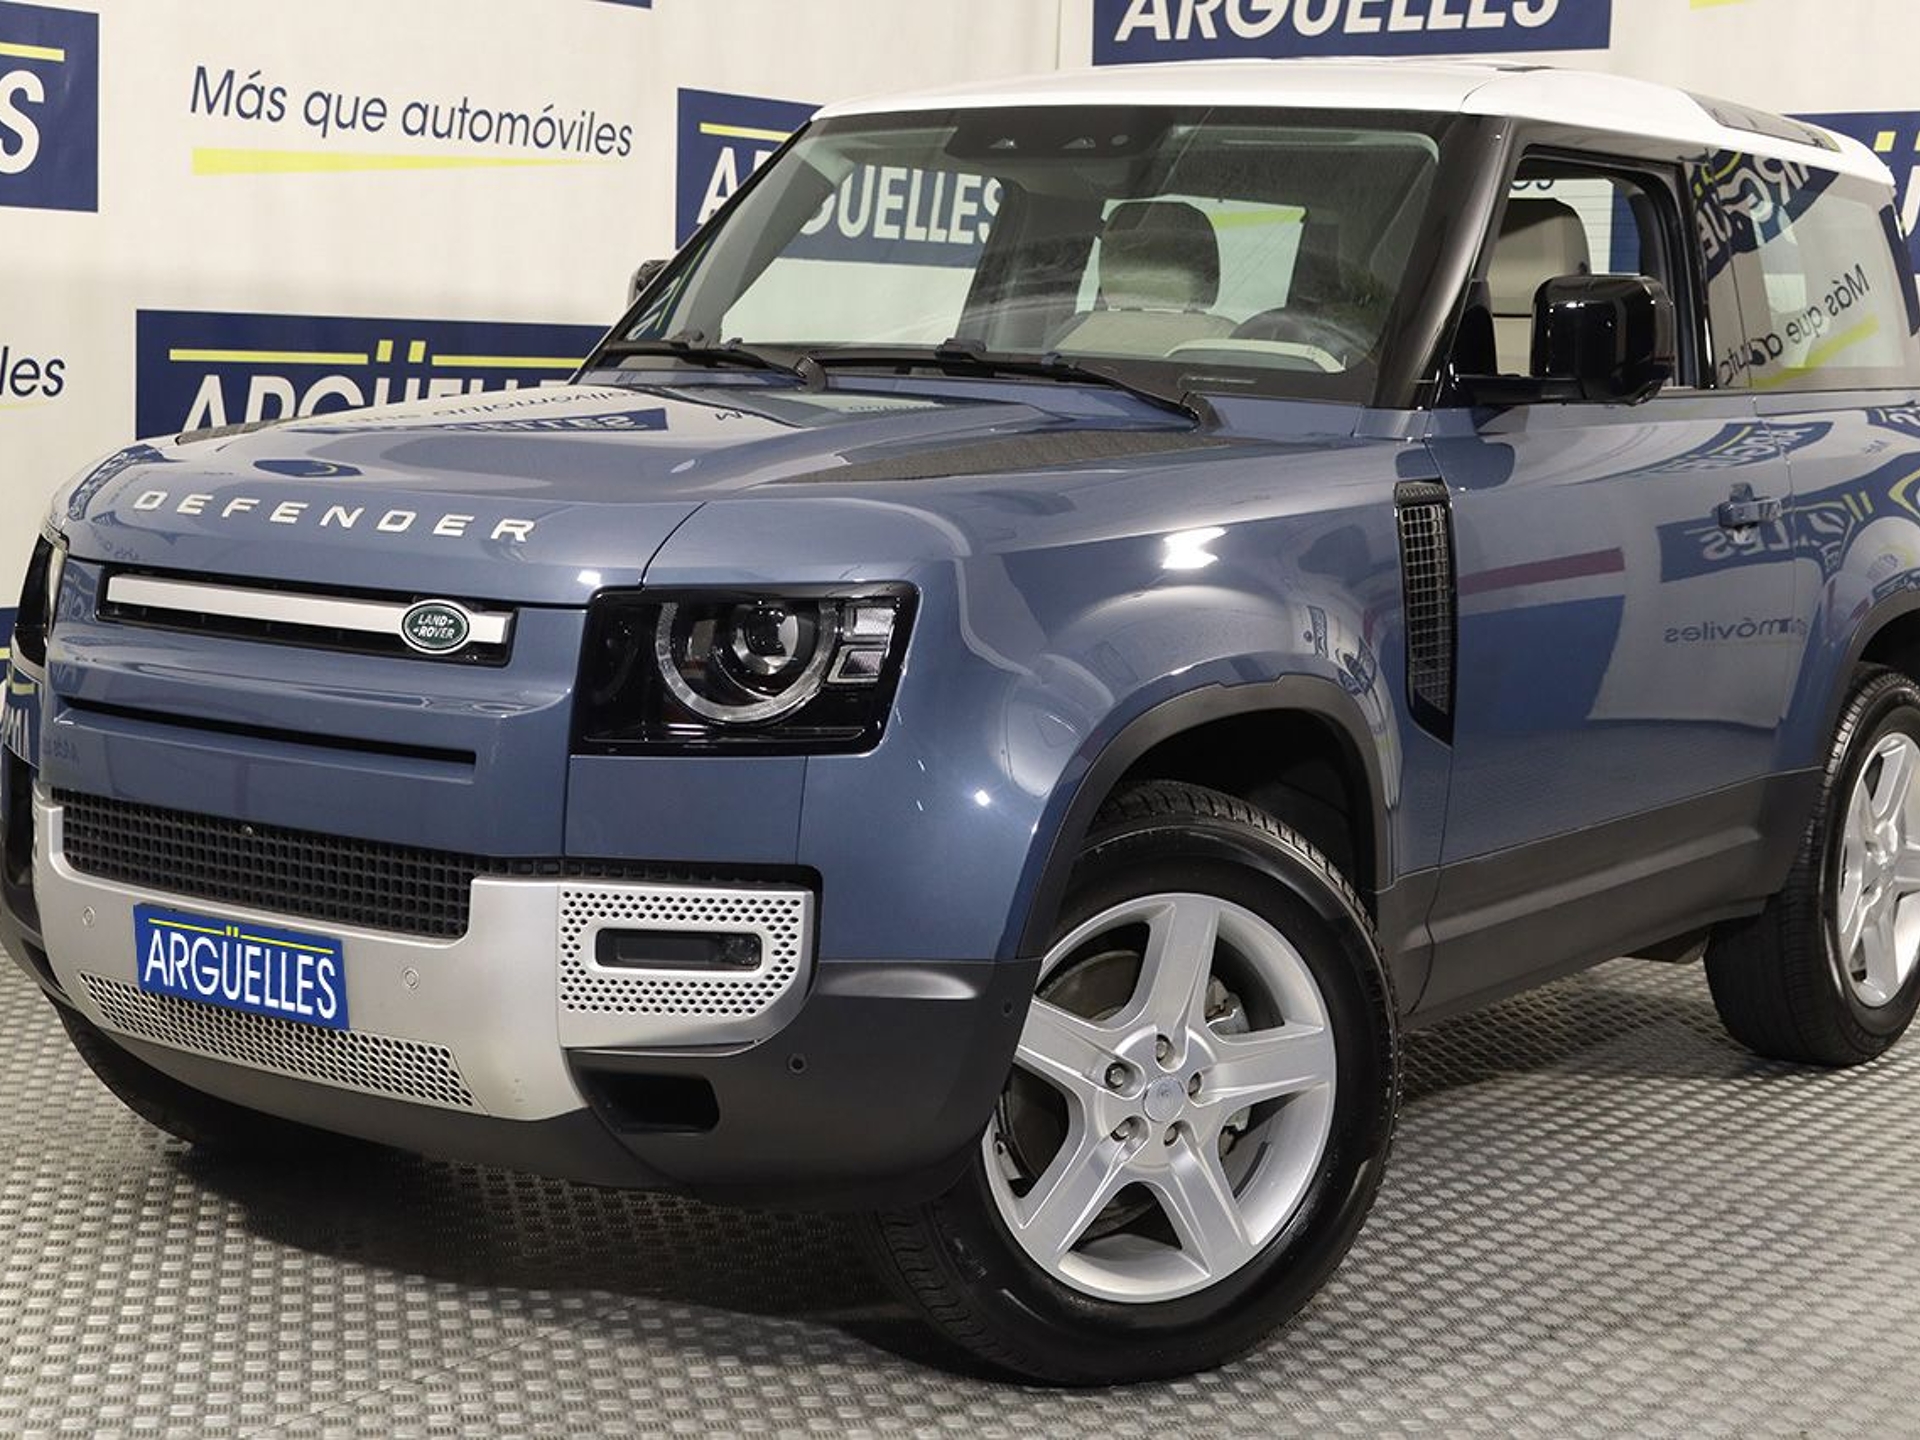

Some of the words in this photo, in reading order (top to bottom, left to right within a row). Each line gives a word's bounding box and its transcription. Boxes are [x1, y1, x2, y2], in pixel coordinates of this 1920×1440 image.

[190, 66, 287, 122] Más
[304, 91, 387, 139] que
[402, 97, 633, 157] automóviles
[133, 490, 536, 543] DEFENDER
[418, 614, 448, 627] LAND
[418, 626, 455, 639] ROVER
[144, 925, 337, 1020] ARGÜELLES
